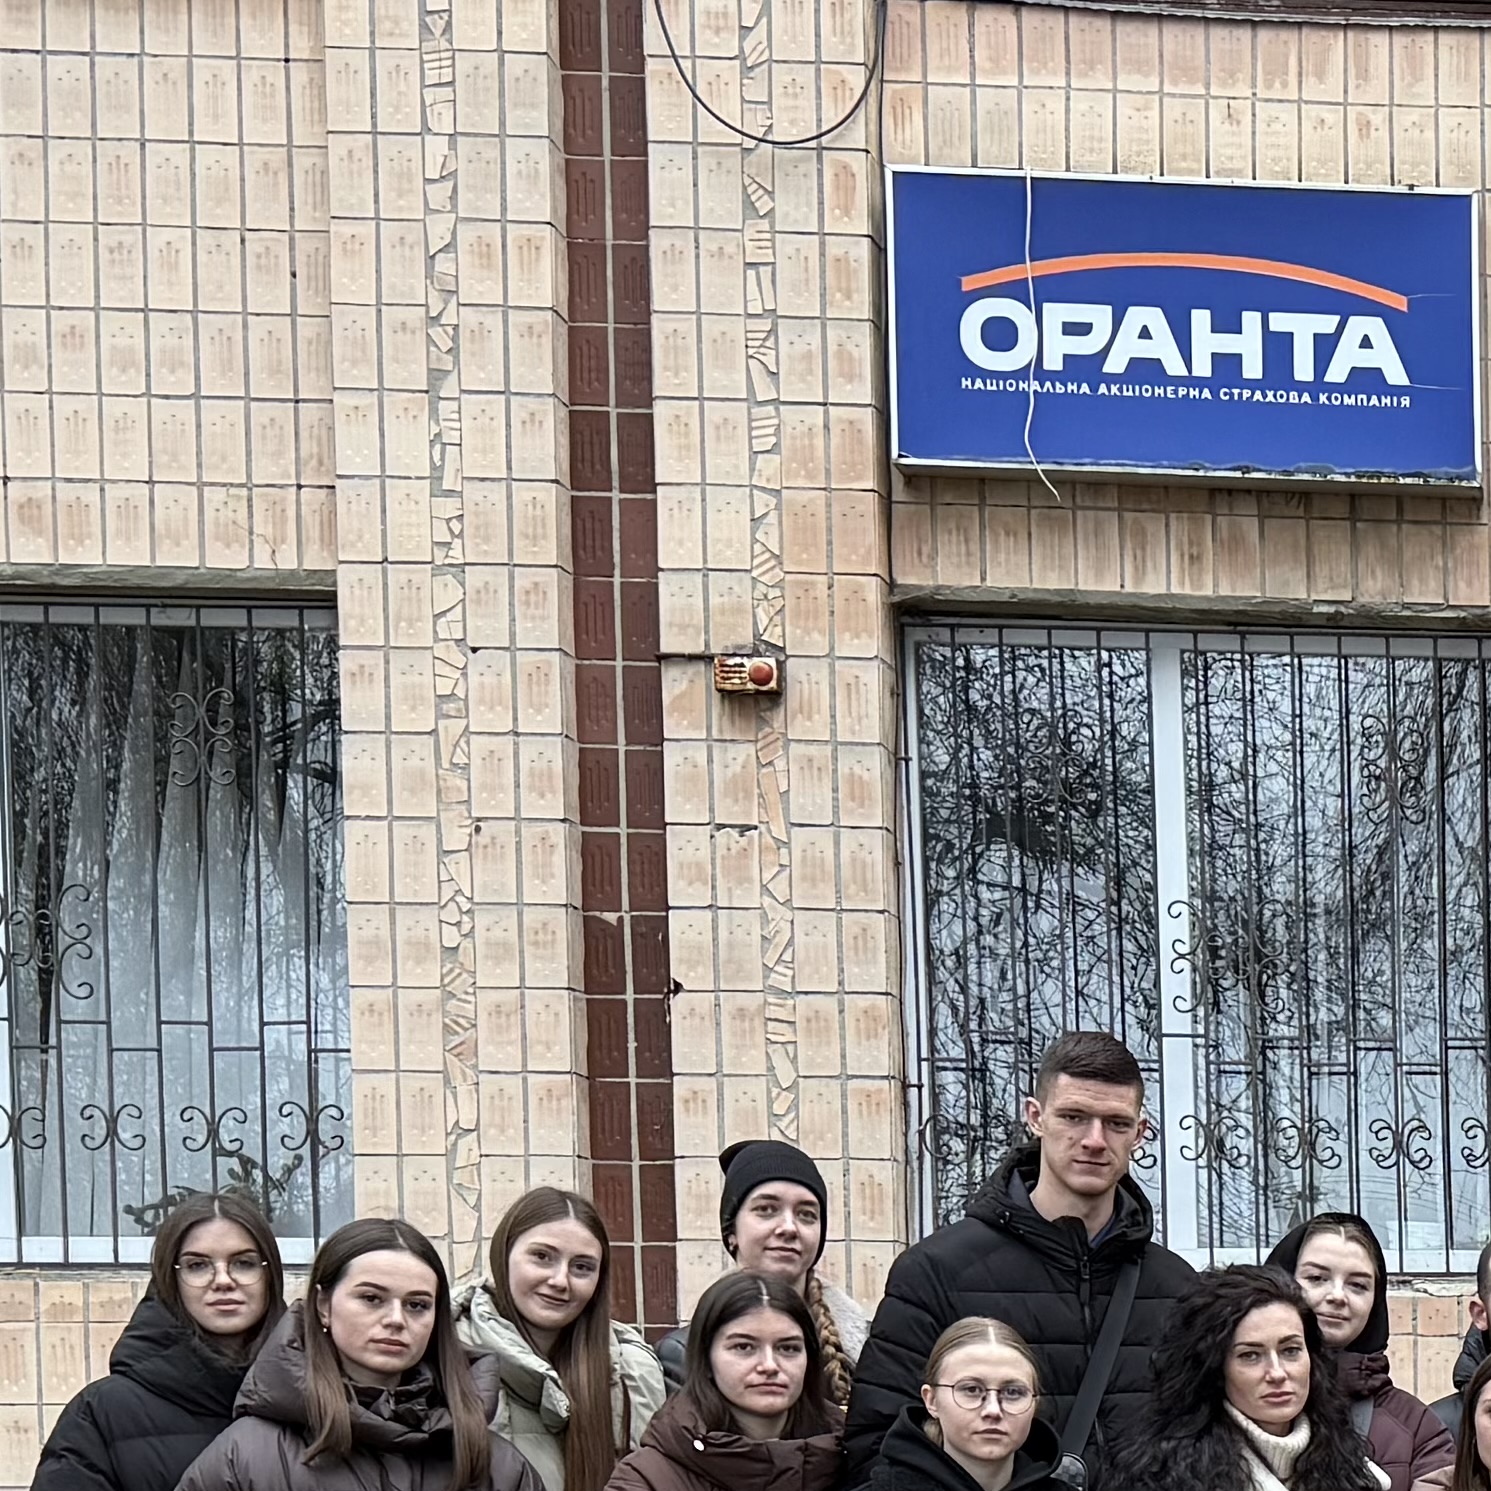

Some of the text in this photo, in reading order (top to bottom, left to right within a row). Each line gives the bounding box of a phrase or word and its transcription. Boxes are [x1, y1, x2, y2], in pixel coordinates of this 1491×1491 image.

[959, 297, 1412, 386] ОРАНТА
[961, 377, 1411, 408] НАЦІОНАЛЬНА АКЦІОНЕРНА СТРАХОВА КОМПАНІЯ
